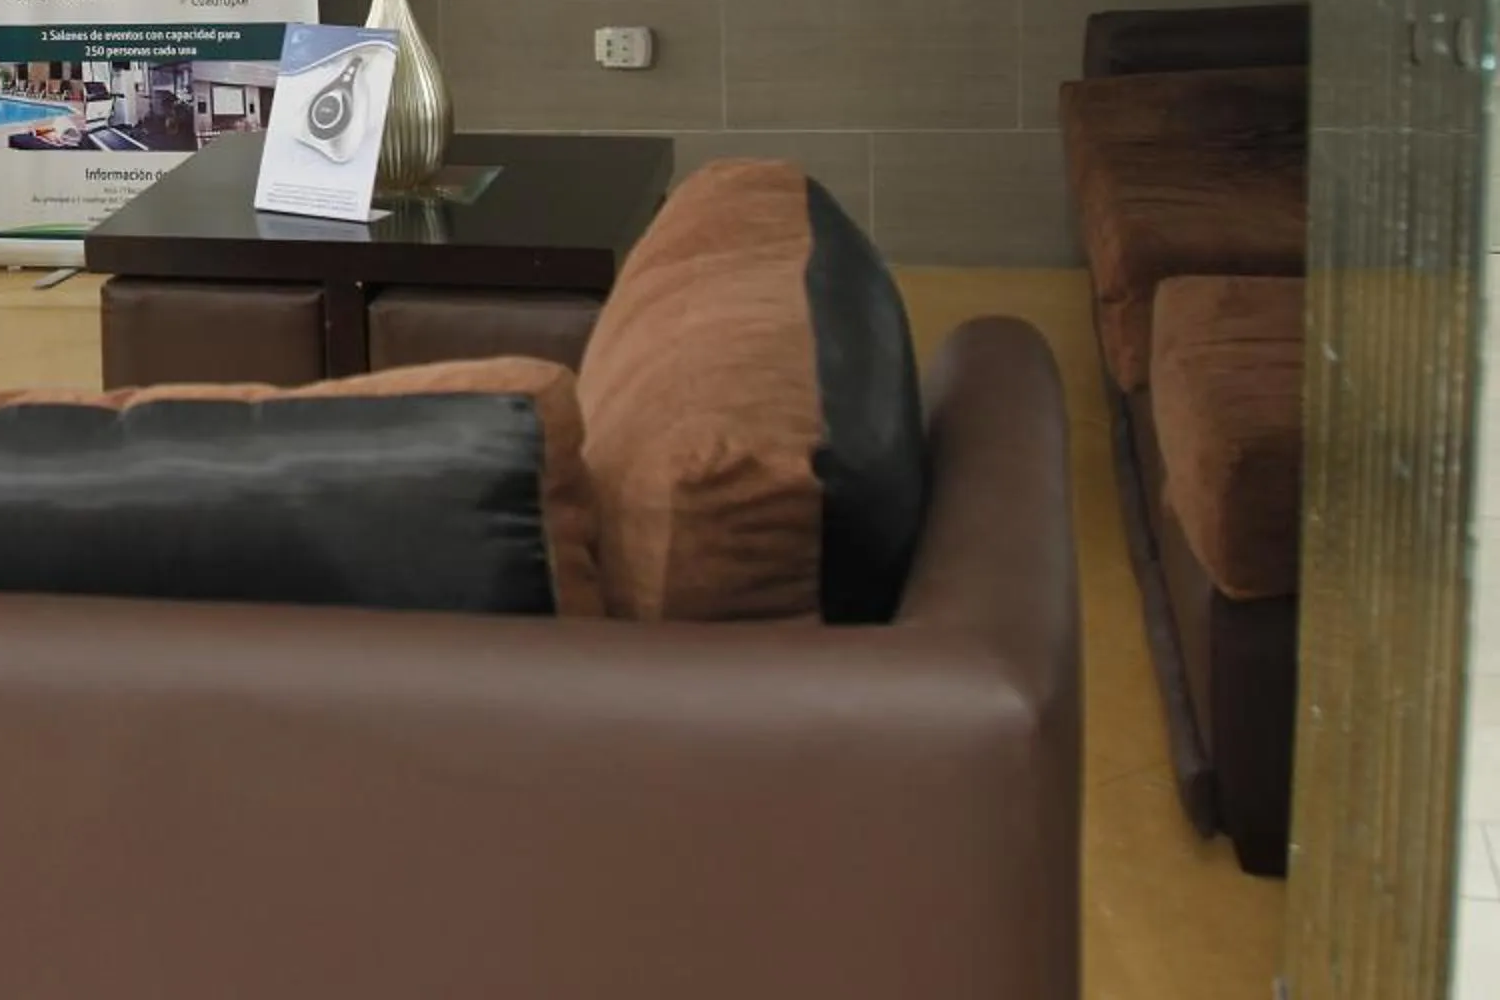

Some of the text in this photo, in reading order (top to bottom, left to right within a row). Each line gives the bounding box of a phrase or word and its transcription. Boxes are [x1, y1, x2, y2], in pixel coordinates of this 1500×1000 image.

[49, 30, 88, 41] Salones
[90, 30, 103, 41] de
[104, 30, 143, 41] eventos
[145, 30, 165, 41] con
[166, 28, 216, 43] capacidad
[217, 29, 240, 42] para
[106, 47, 151, 58] personas
[153, 45, 176, 56] cada
[177, 45, 198, 55] una
[85, 167, 153, 181] Información
